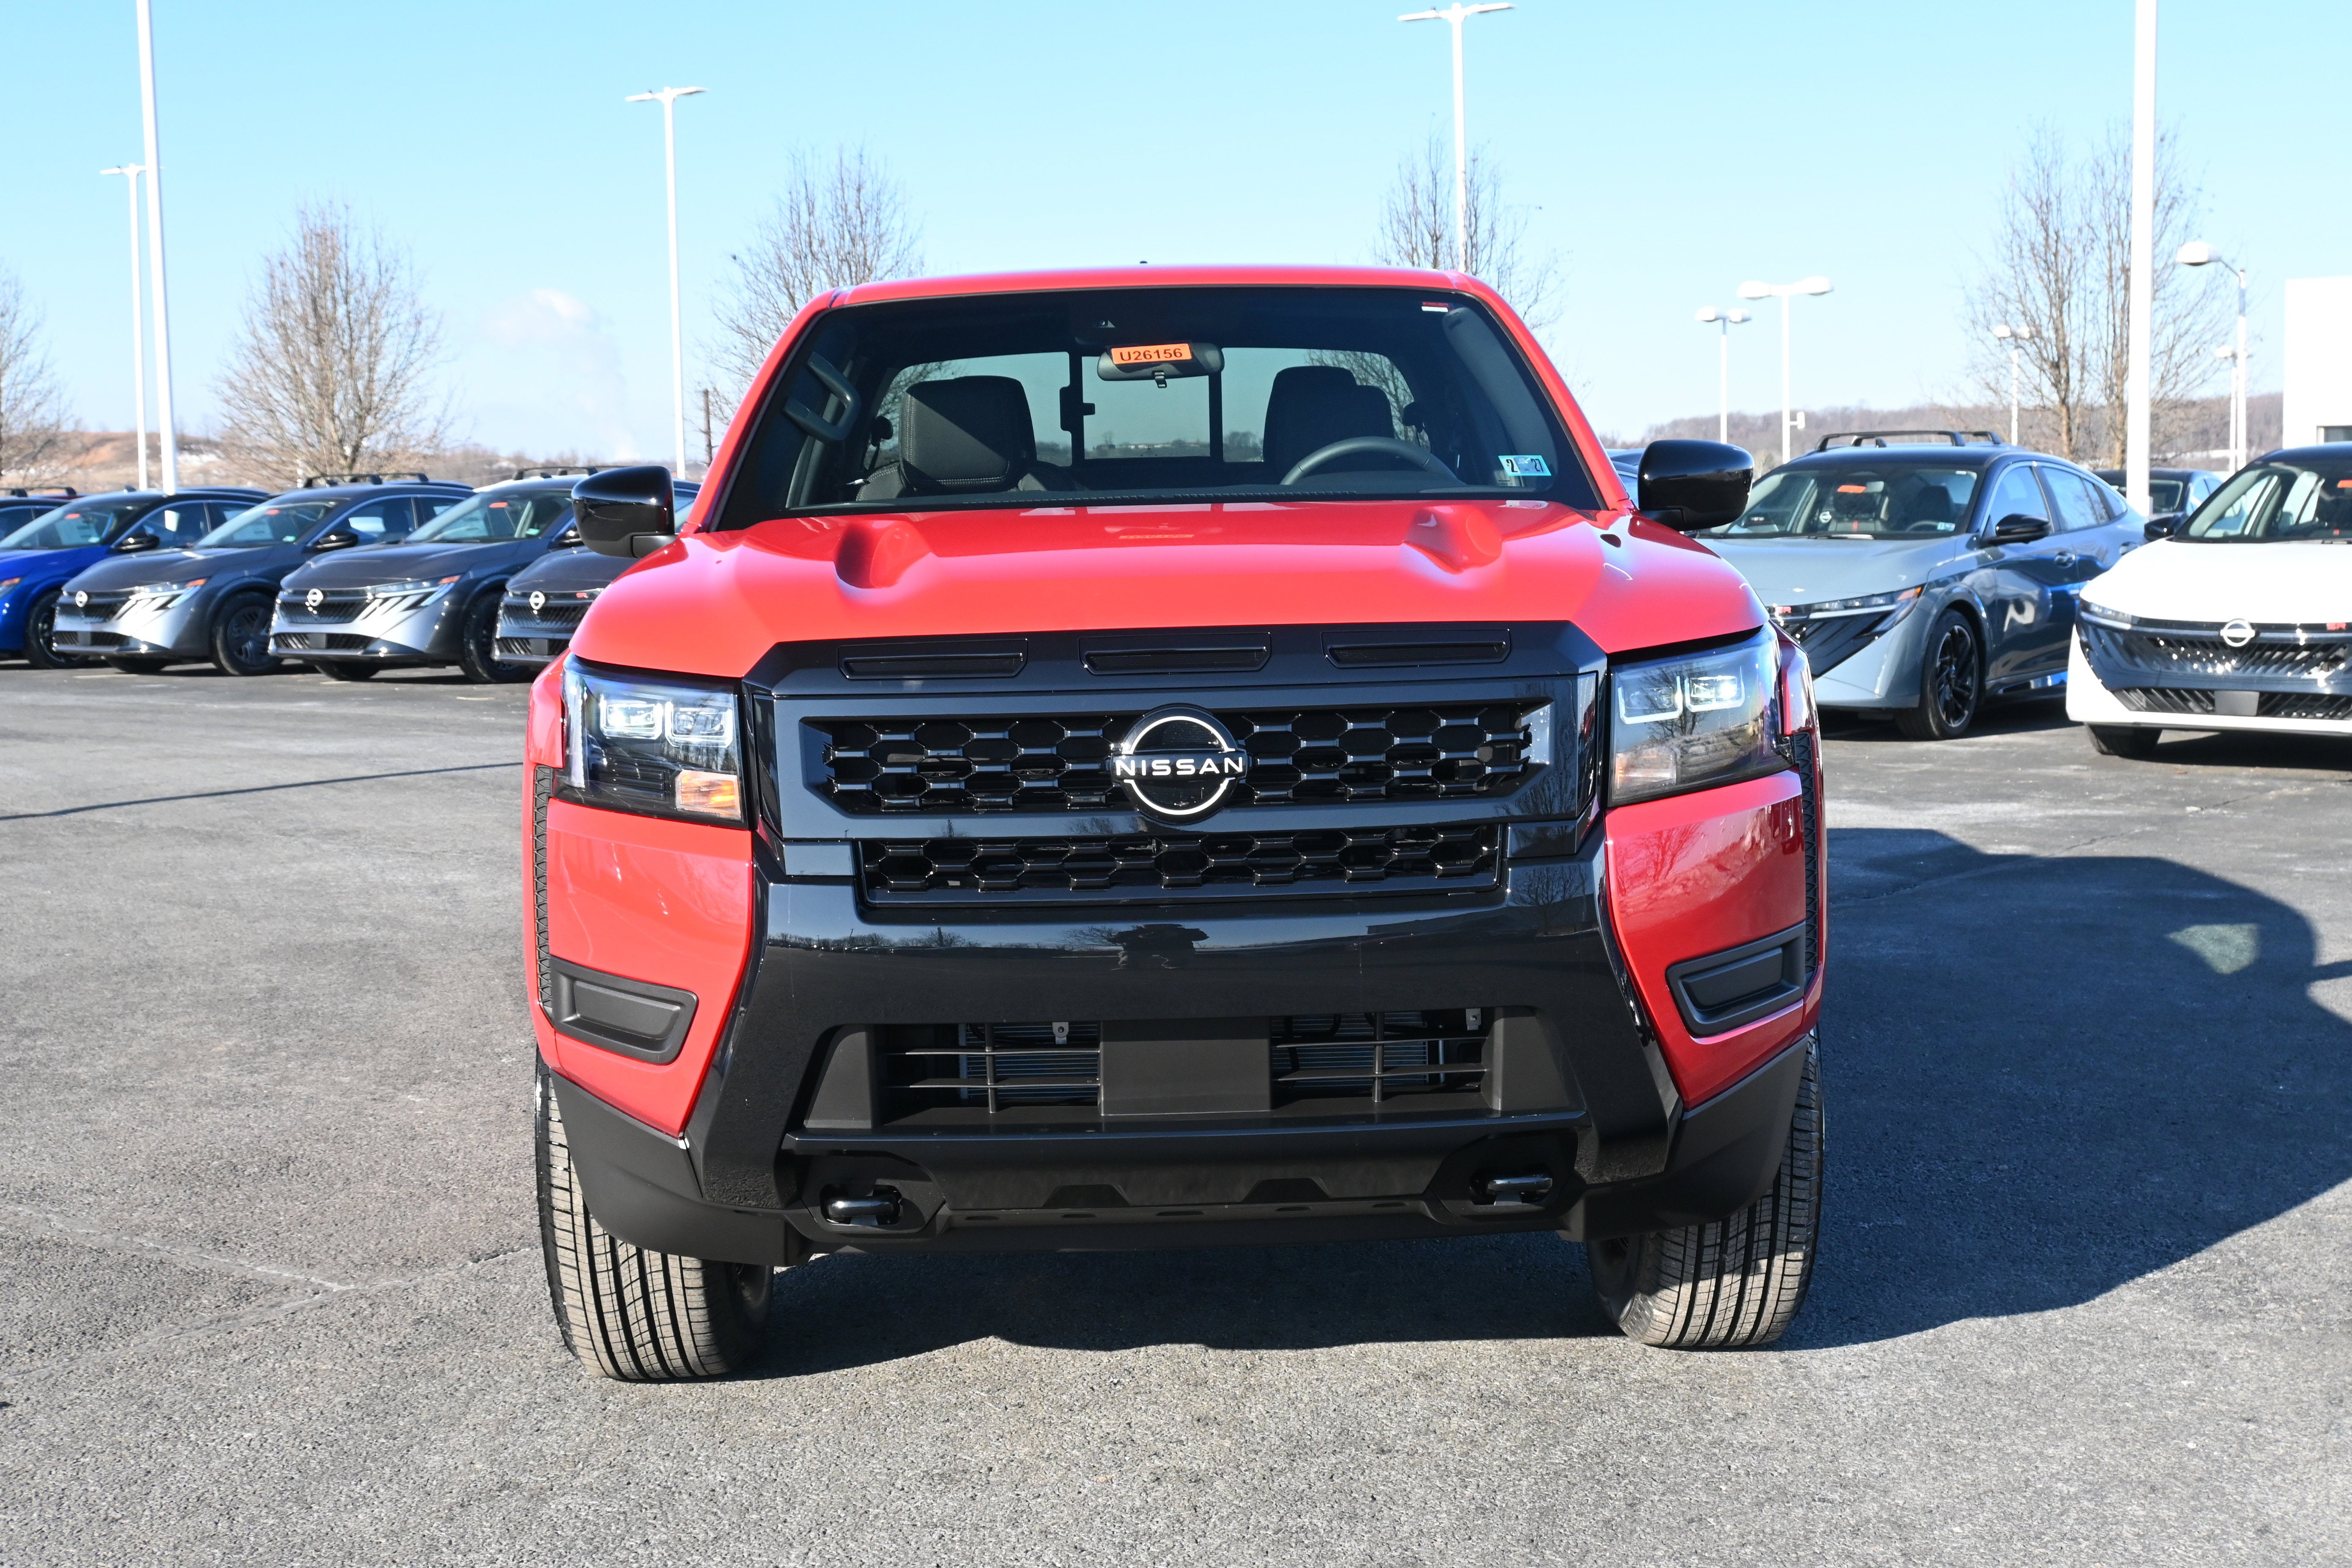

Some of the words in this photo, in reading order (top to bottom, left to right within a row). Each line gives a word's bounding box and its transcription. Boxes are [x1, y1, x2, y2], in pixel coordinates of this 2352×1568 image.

[1120, 348, 1183, 361] U26156
[1506, 459, 1518, 473] 2
[1530, 458, 1544, 473] 27
[1116, 757, 1243, 776] NISSAN
